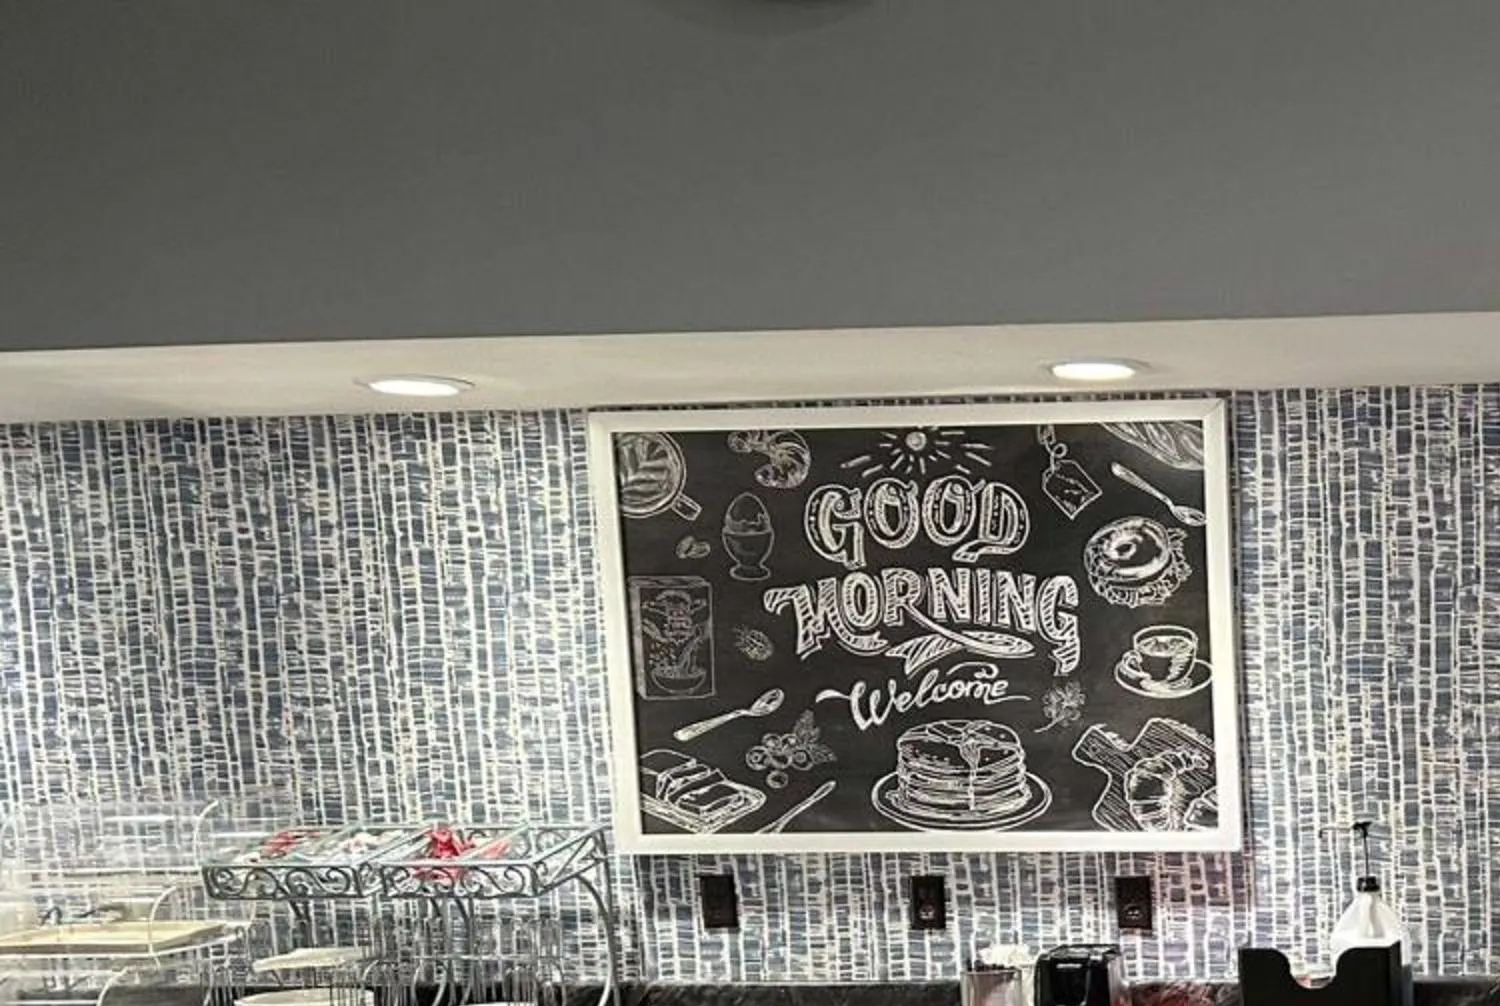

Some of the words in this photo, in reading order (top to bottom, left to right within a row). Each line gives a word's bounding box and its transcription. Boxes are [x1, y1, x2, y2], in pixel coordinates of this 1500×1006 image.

[804, 474, 1031, 570] GOOD
[764, 567, 1081, 678] MORNING
[815, 661, 1032, 731] Welcome
